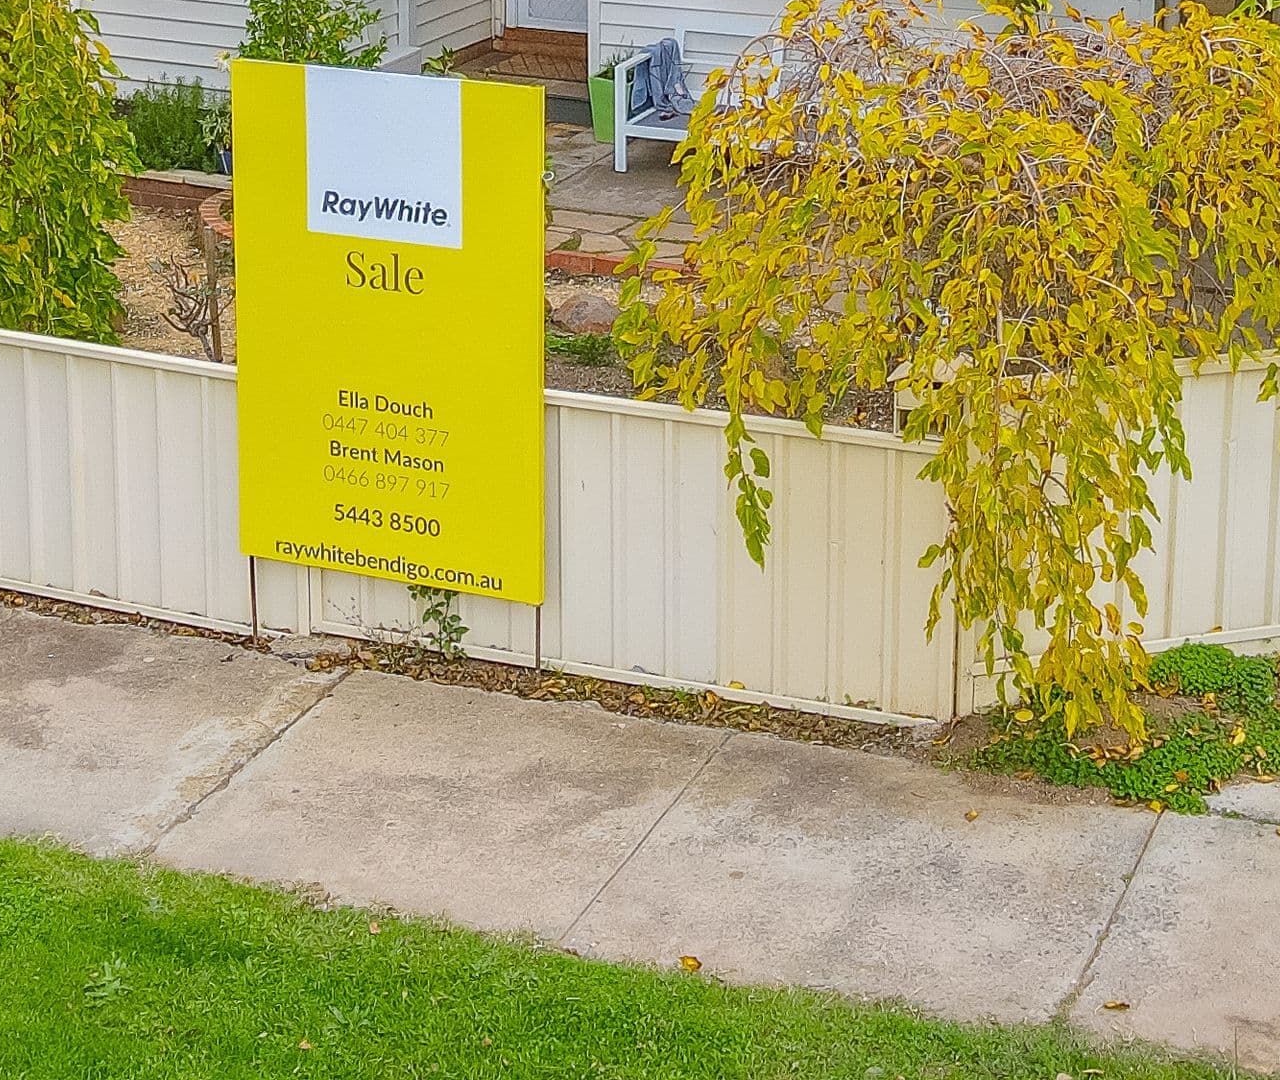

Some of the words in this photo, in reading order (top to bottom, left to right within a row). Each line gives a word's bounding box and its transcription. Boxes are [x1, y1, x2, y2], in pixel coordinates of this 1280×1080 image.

[346, 251, 424, 294] Sale
[338, 390, 369, 410] Ella
[375, 395, 433, 419] Douch
[322, 413, 368, 435] 0447
[374, 422, 409, 441] 404
[416, 428, 449, 447] 377
[329, 440, 379, 463] Brent
[384, 449, 444, 472] Mason
[323, 465, 369, 487] 0466
[375, 473, 409, 493] 897
[416, 479, 450, 499] 917
[334, 504, 383, 528] 5443
[389, 513, 441, 537] 8500
[275, 540, 503, 591] raywhitebendigo.com.au
